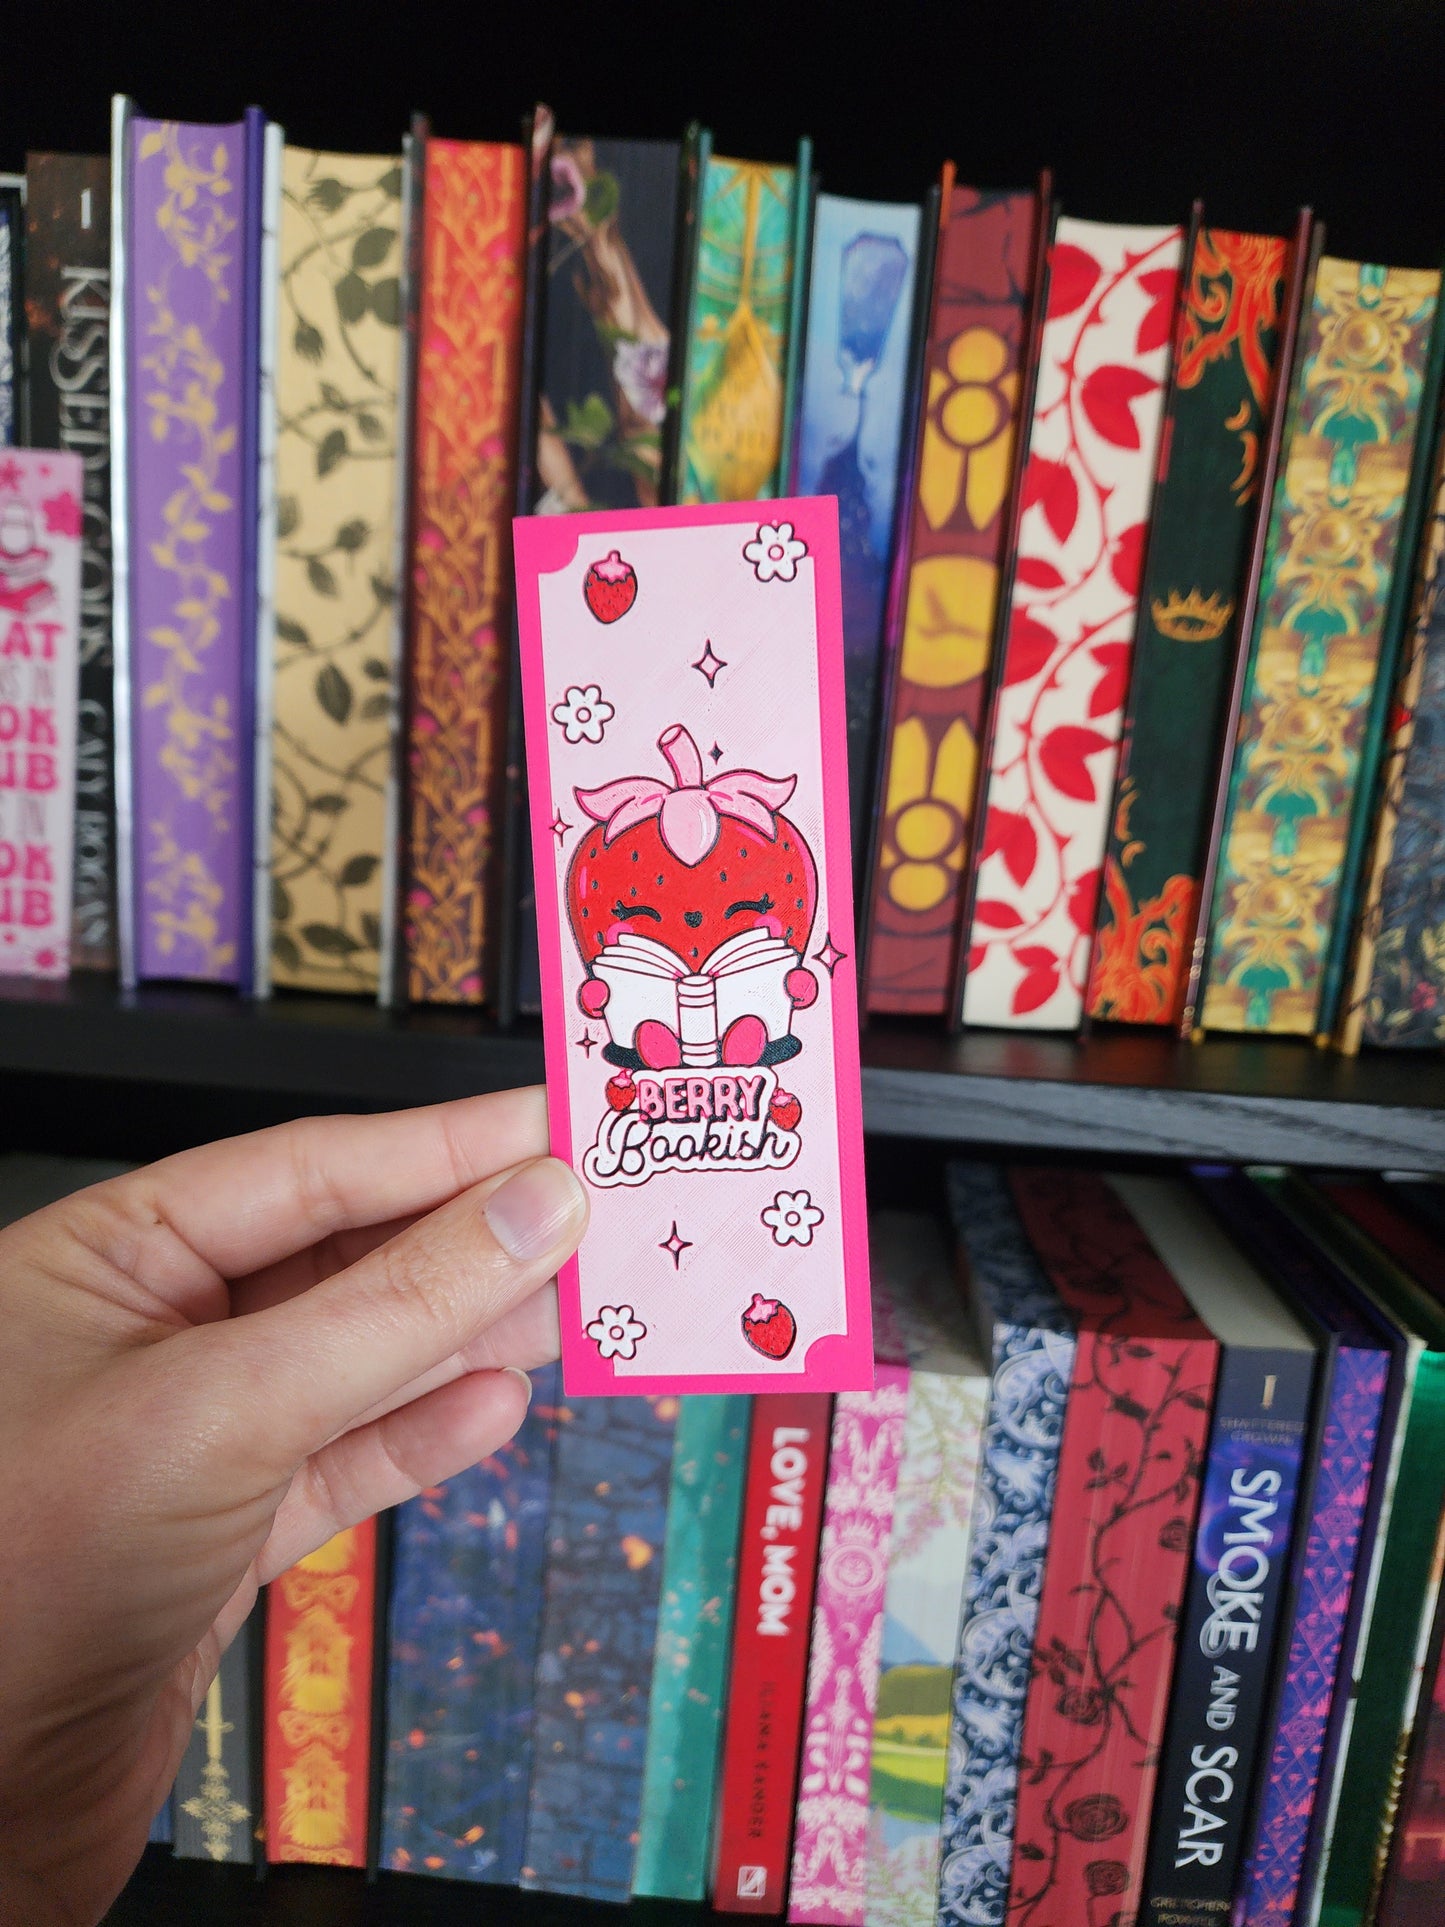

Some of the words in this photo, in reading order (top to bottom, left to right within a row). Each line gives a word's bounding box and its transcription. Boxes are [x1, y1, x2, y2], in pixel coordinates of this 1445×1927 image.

[592, 1110, 791, 1177] Bookish
[638, 1076, 766, 1124] BERRY
[760, 1426, 810, 1541] LOVE,
[756, 1545, 798, 1637] MOM
[1204, 1468, 1282, 1654] SMOKE
[1206, 1665, 1241, 1731] AND
[1175, 1744, 1239, 1869] SCAR
